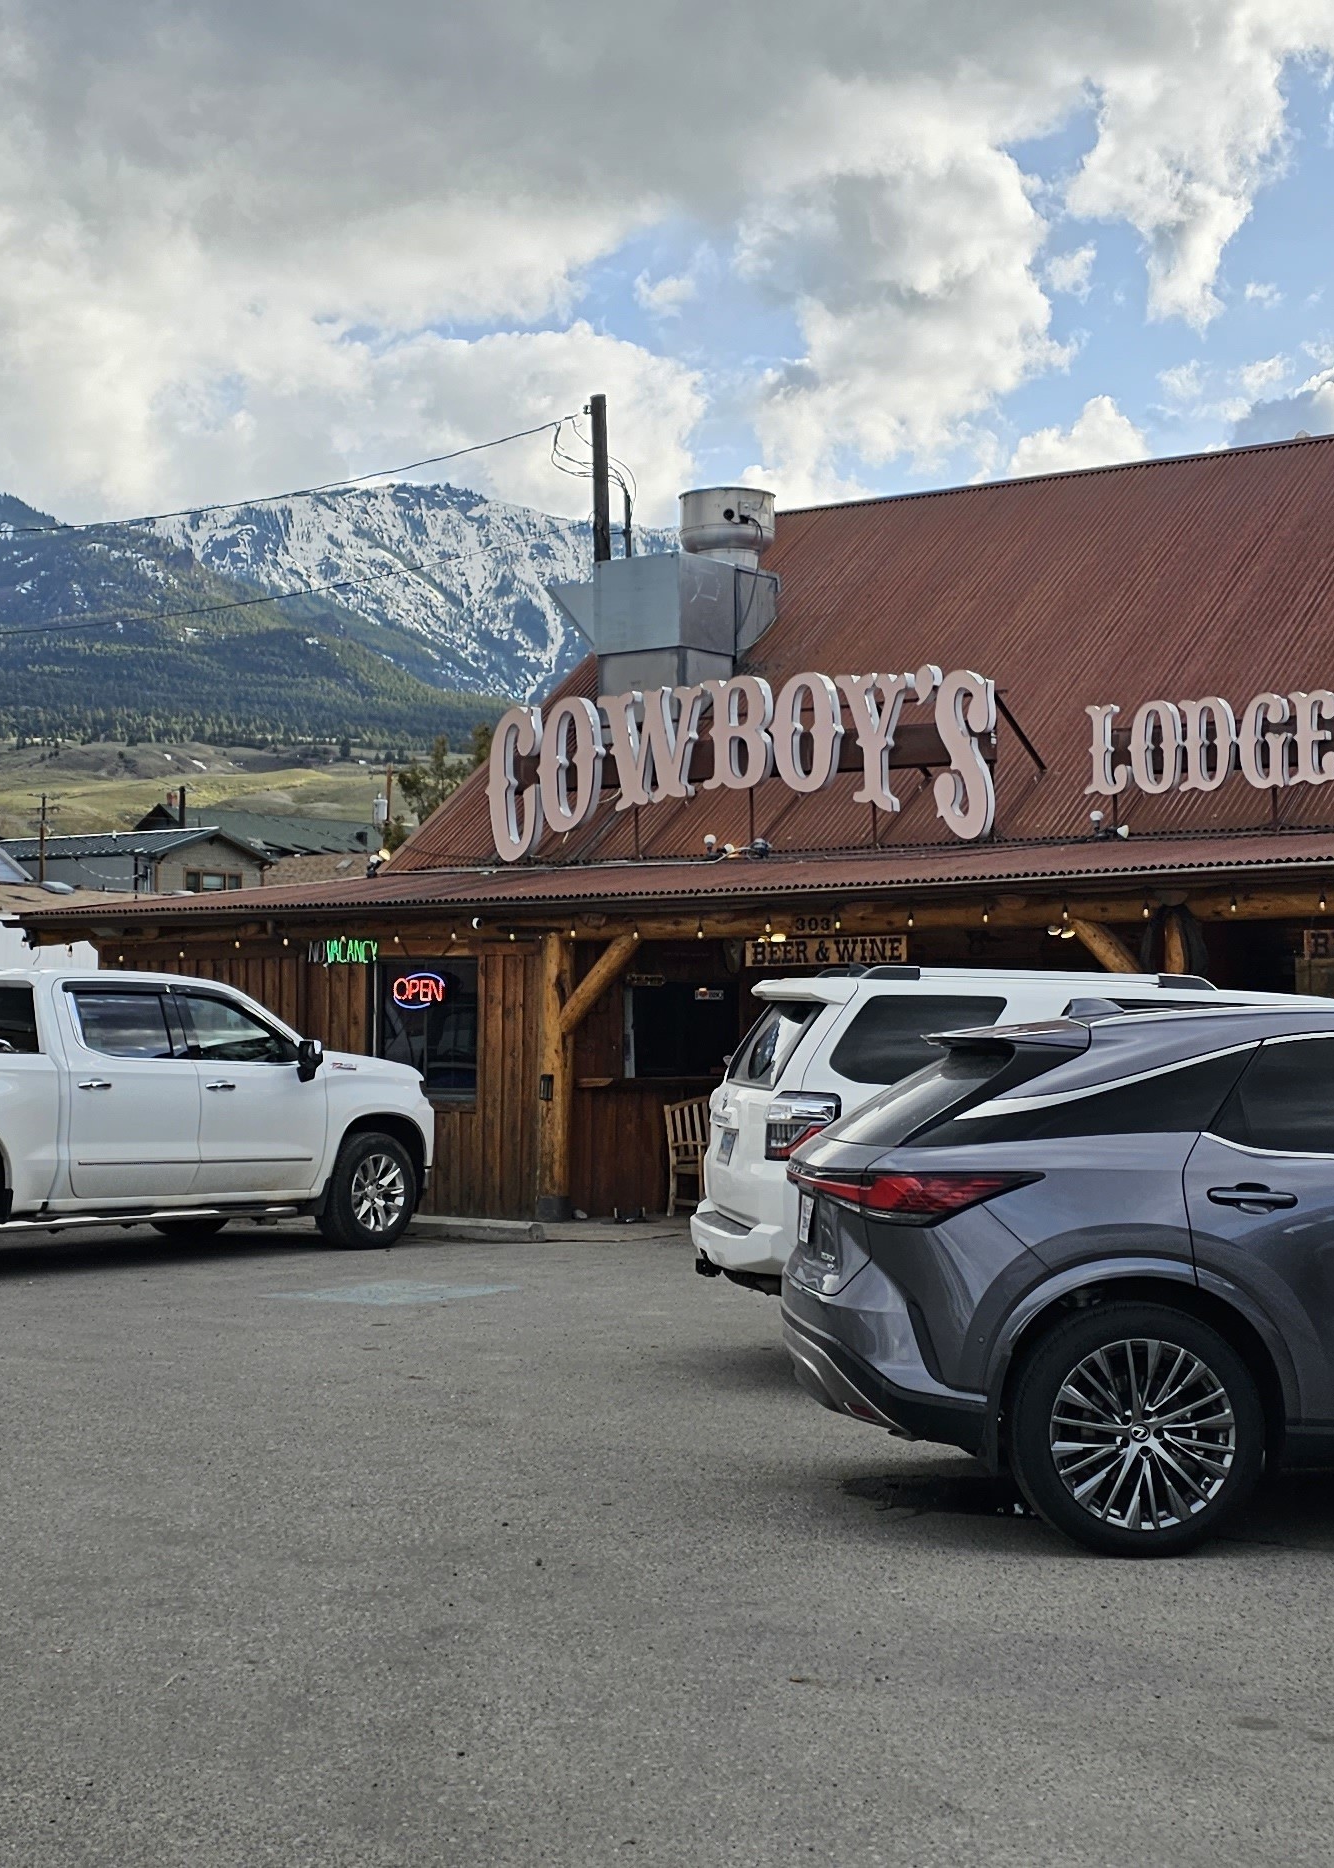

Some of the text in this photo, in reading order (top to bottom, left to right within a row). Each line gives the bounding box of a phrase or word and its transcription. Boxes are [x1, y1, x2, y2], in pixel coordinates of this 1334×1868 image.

[485, 664, 996, 862] COWBOY'S
[795, 917, 831, 932] 303
[326, 936, 378, 964] VACANCY
[751, 937, 903, 965] BEER & WINE
[393, 977, 444, 1002] OPEN
